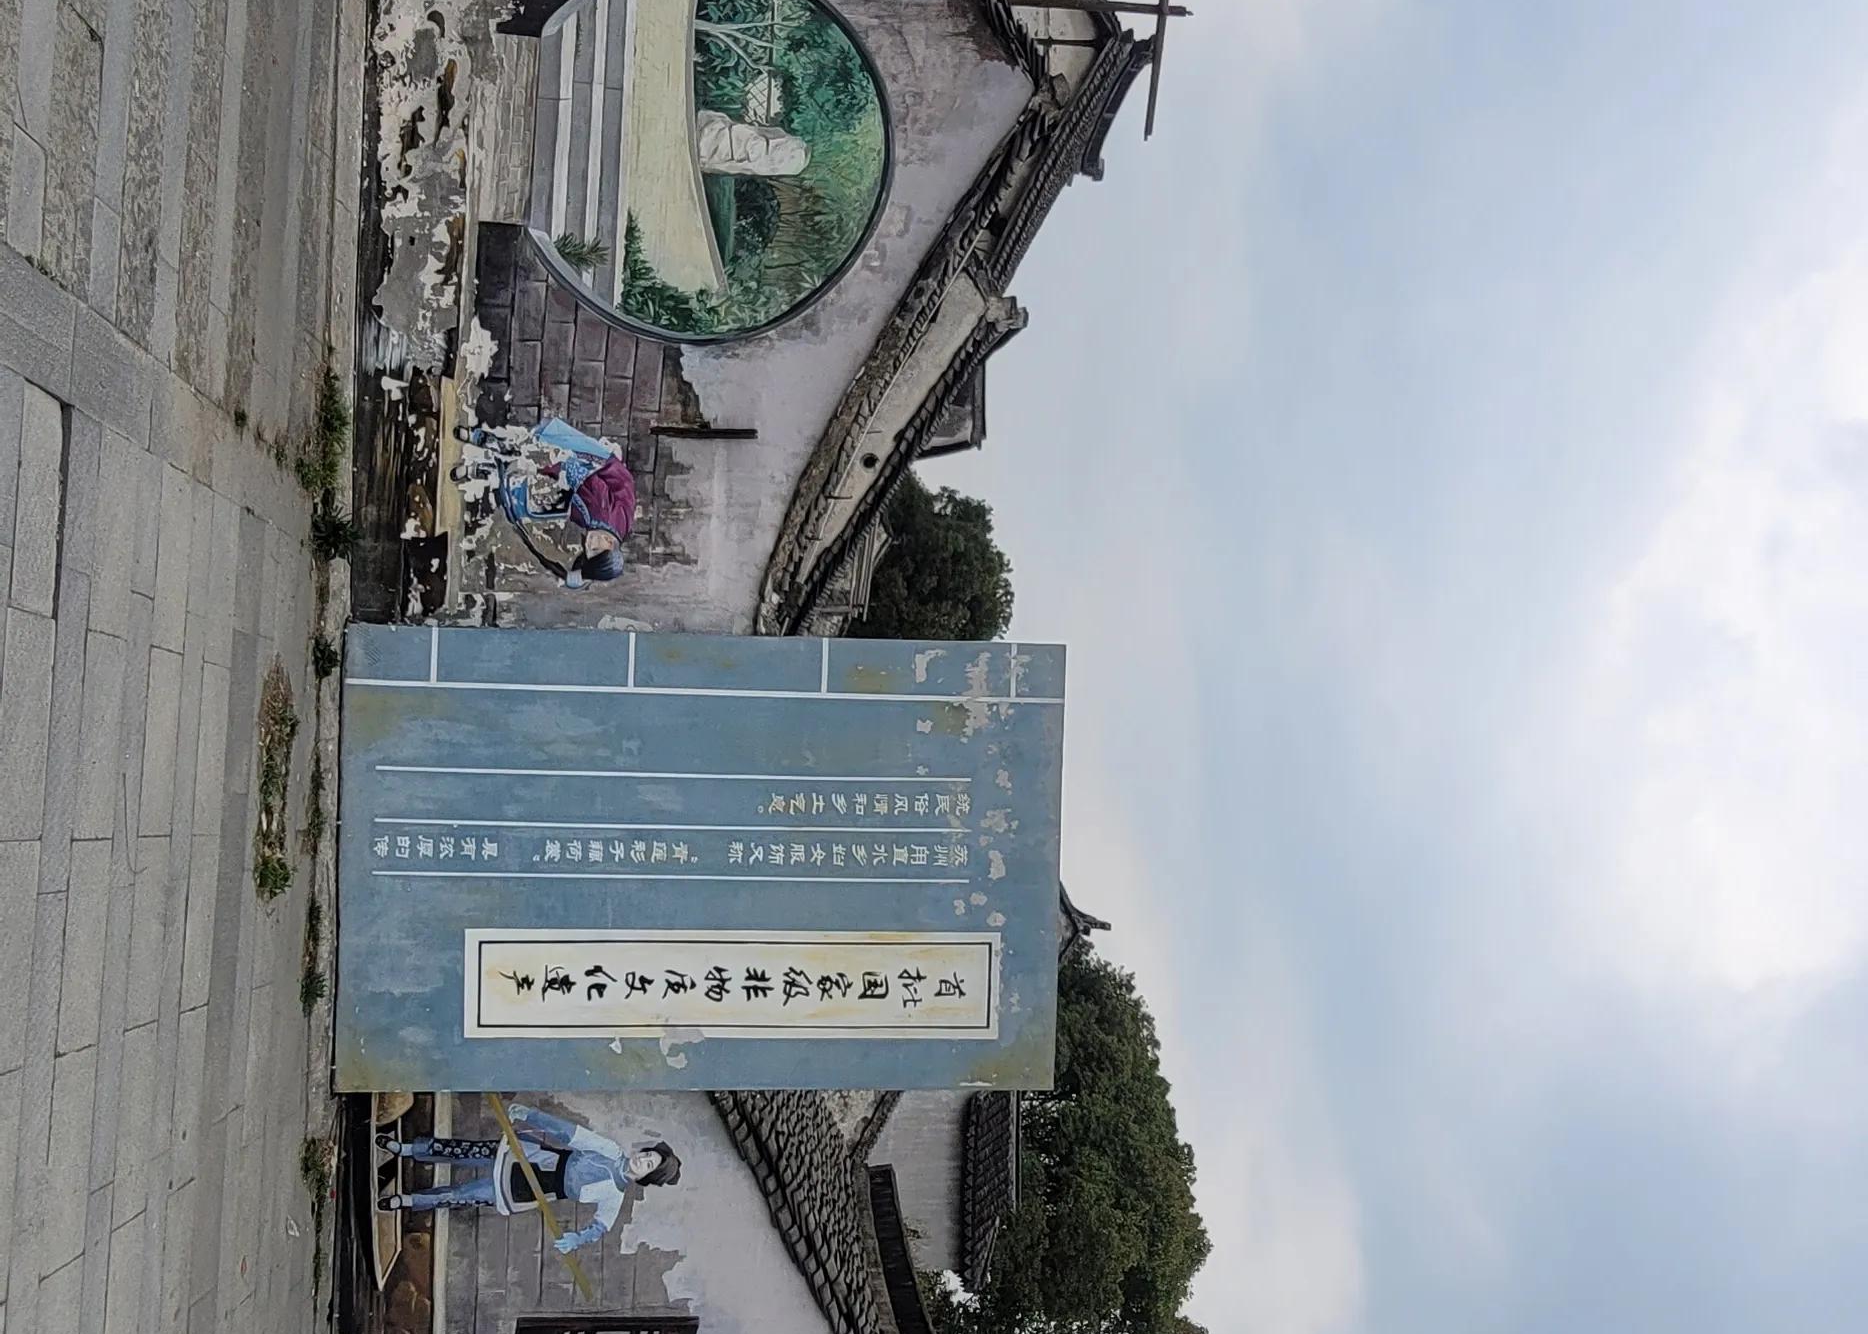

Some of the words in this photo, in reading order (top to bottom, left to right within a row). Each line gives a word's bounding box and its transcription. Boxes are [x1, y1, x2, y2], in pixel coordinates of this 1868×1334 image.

[499, 964, 966, 1009] 首批国家级非物质文化遗产
